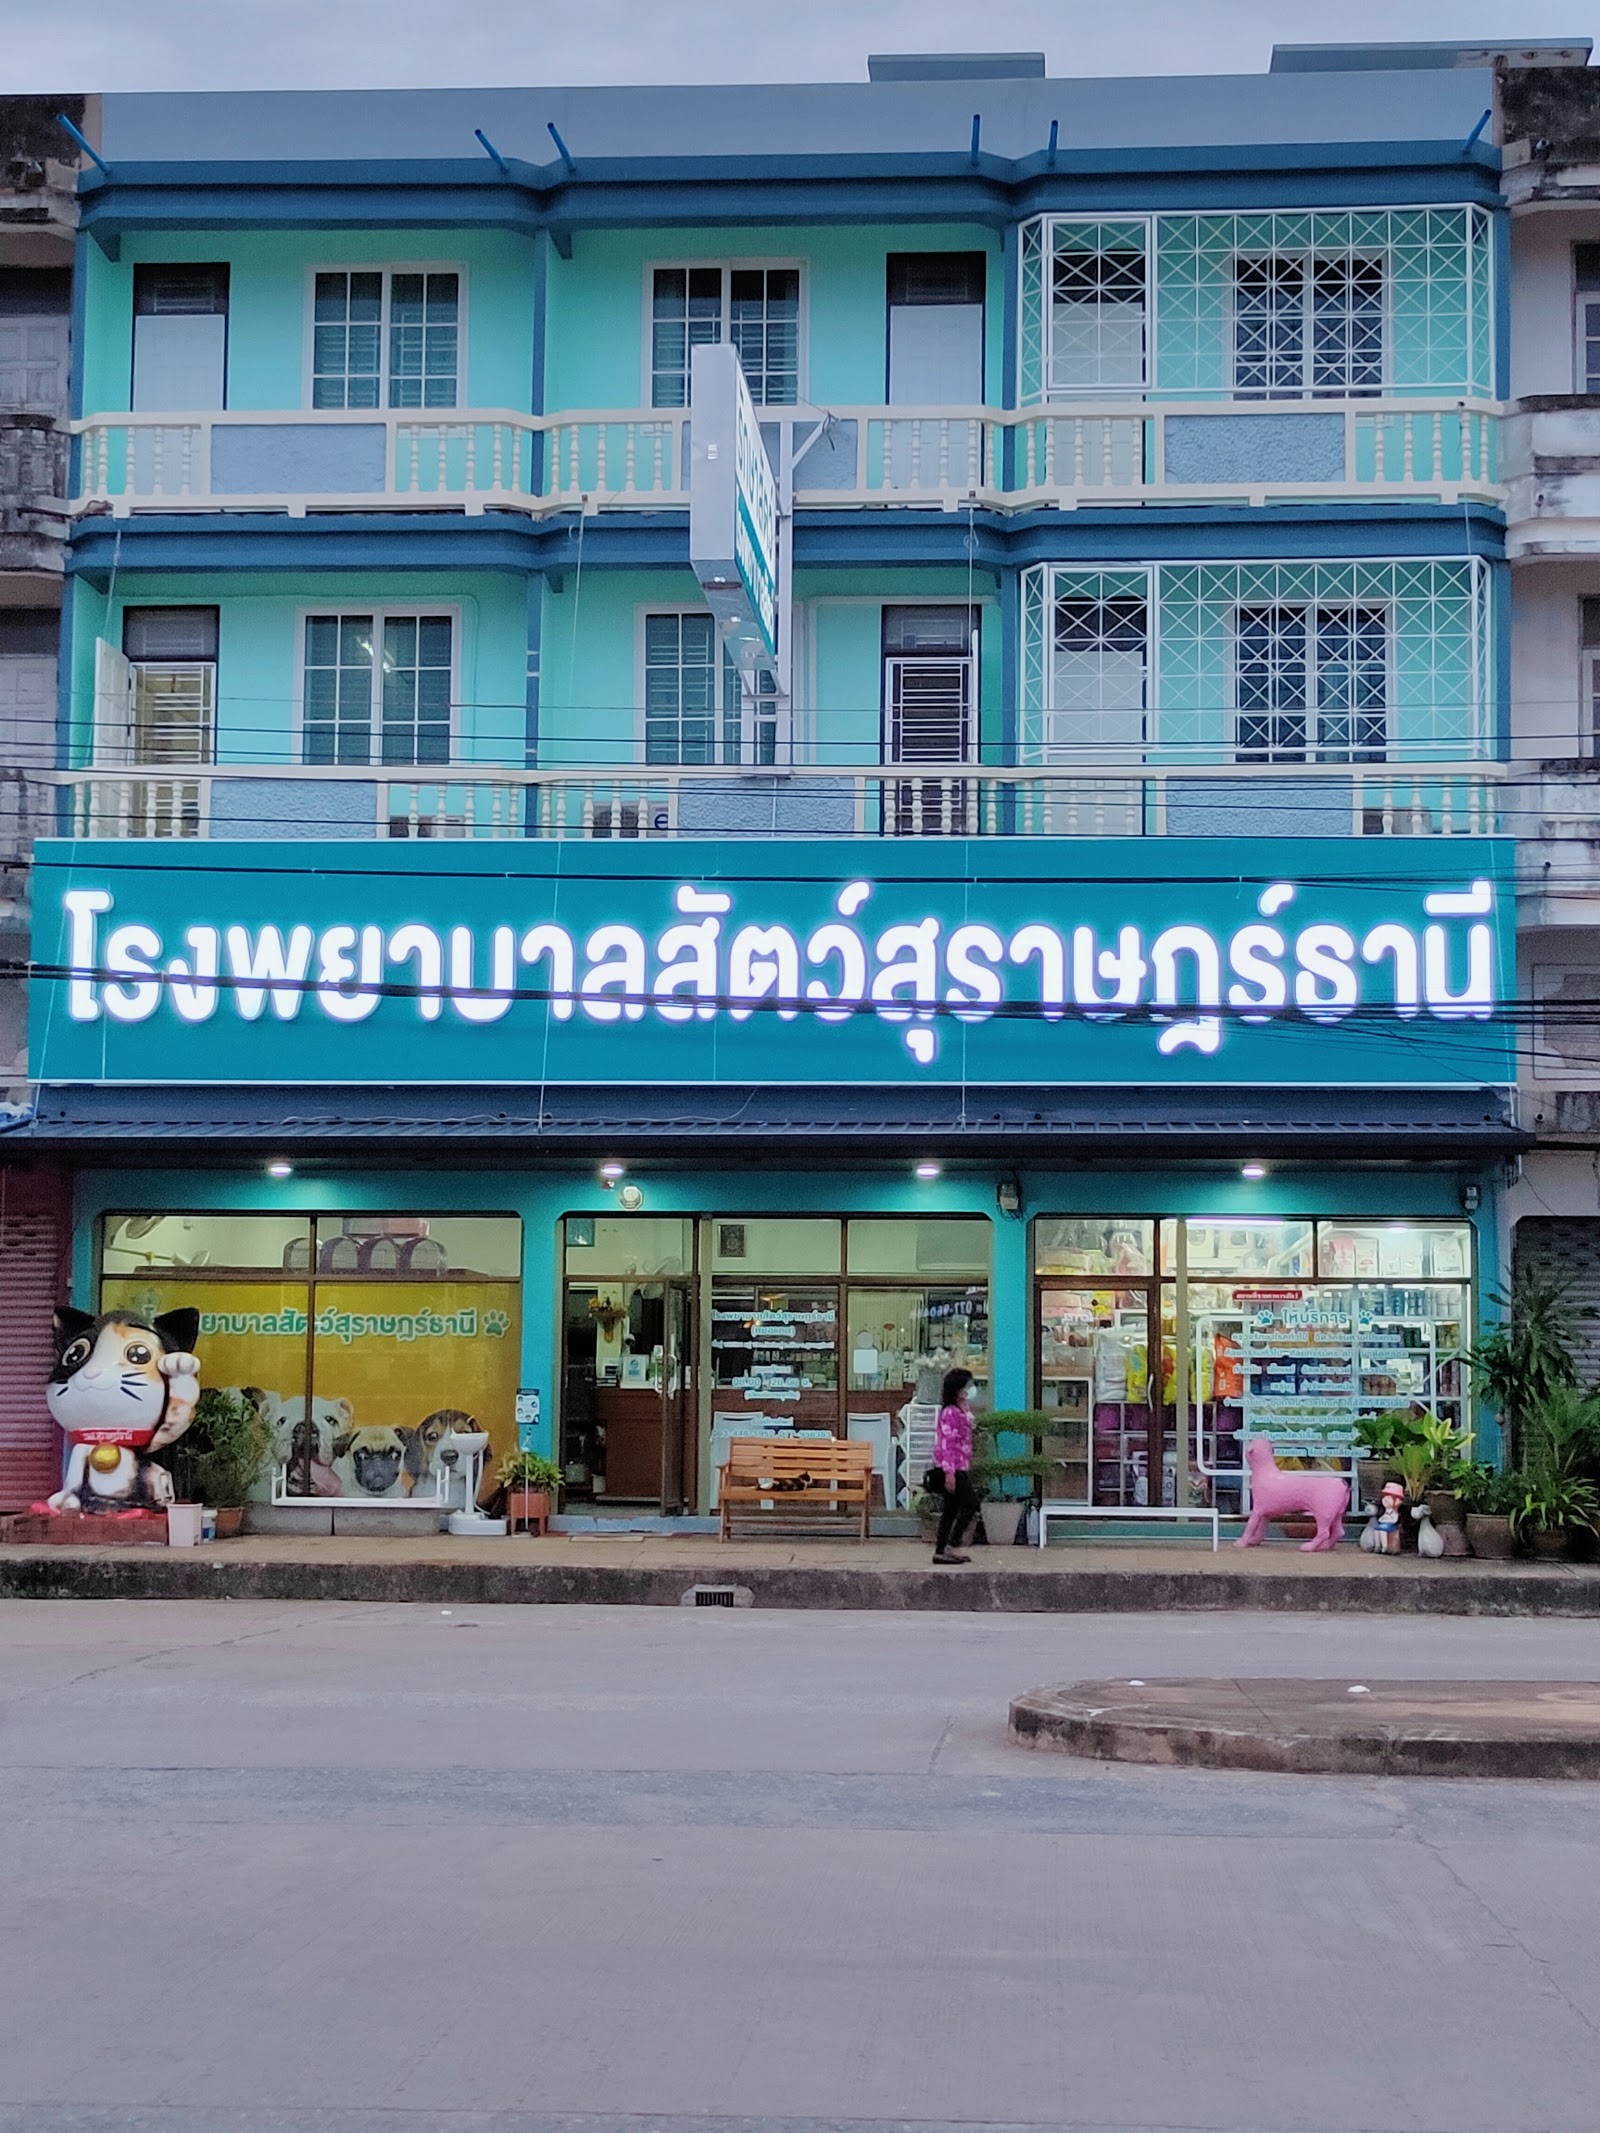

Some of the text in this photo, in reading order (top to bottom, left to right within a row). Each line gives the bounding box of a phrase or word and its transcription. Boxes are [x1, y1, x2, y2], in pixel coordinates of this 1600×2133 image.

[63, 878, 1495, 1065] โรงพยาบาลสัตว์สุราษฎร์ธานี
[1282, 1307, 1347, 1324] ให้บริการ
